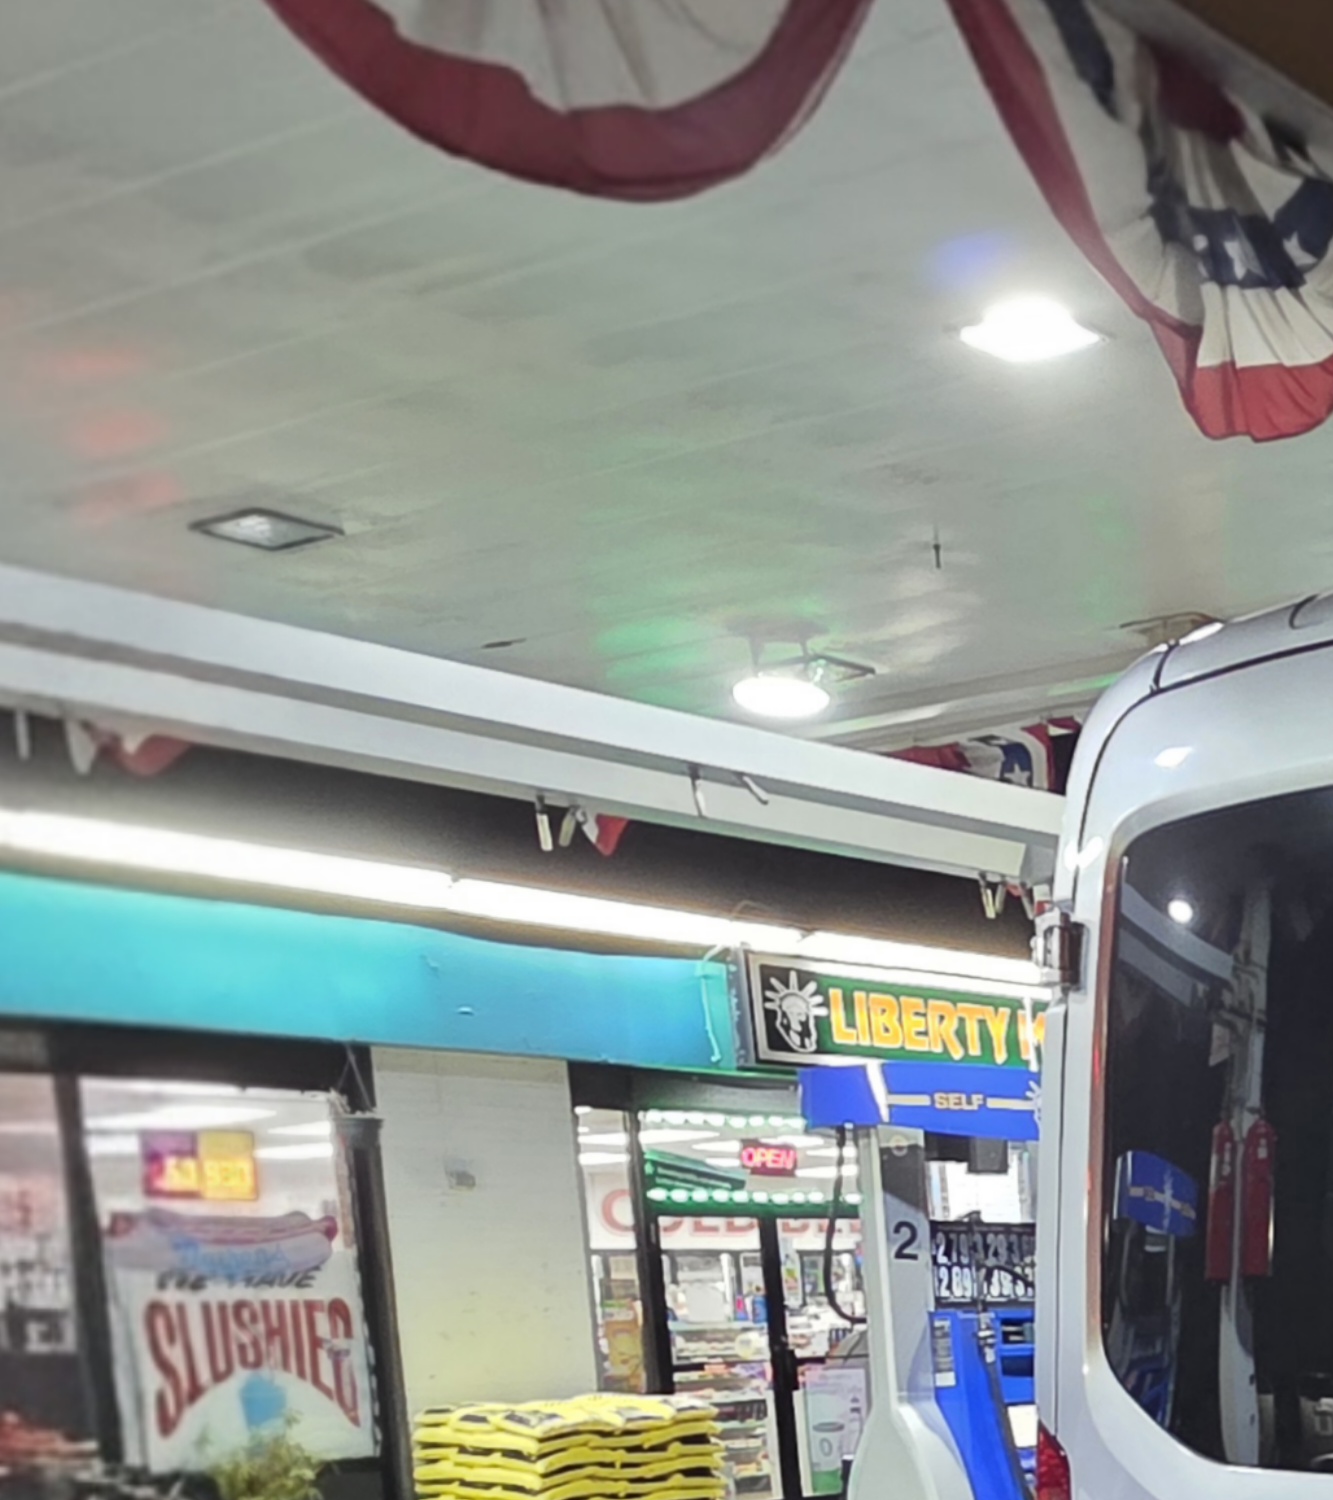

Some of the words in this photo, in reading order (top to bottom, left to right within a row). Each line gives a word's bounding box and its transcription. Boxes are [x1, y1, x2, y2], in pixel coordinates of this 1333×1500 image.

[828, 987, 1011, 1066] LIBERTY
[933, 1092, 985, 1112] SELF
[741, 1146, 797, 1170] OPEN
[894, 1221, 920, 1261] 2
[144, 1297, 362, 1439] SLUSHIES
